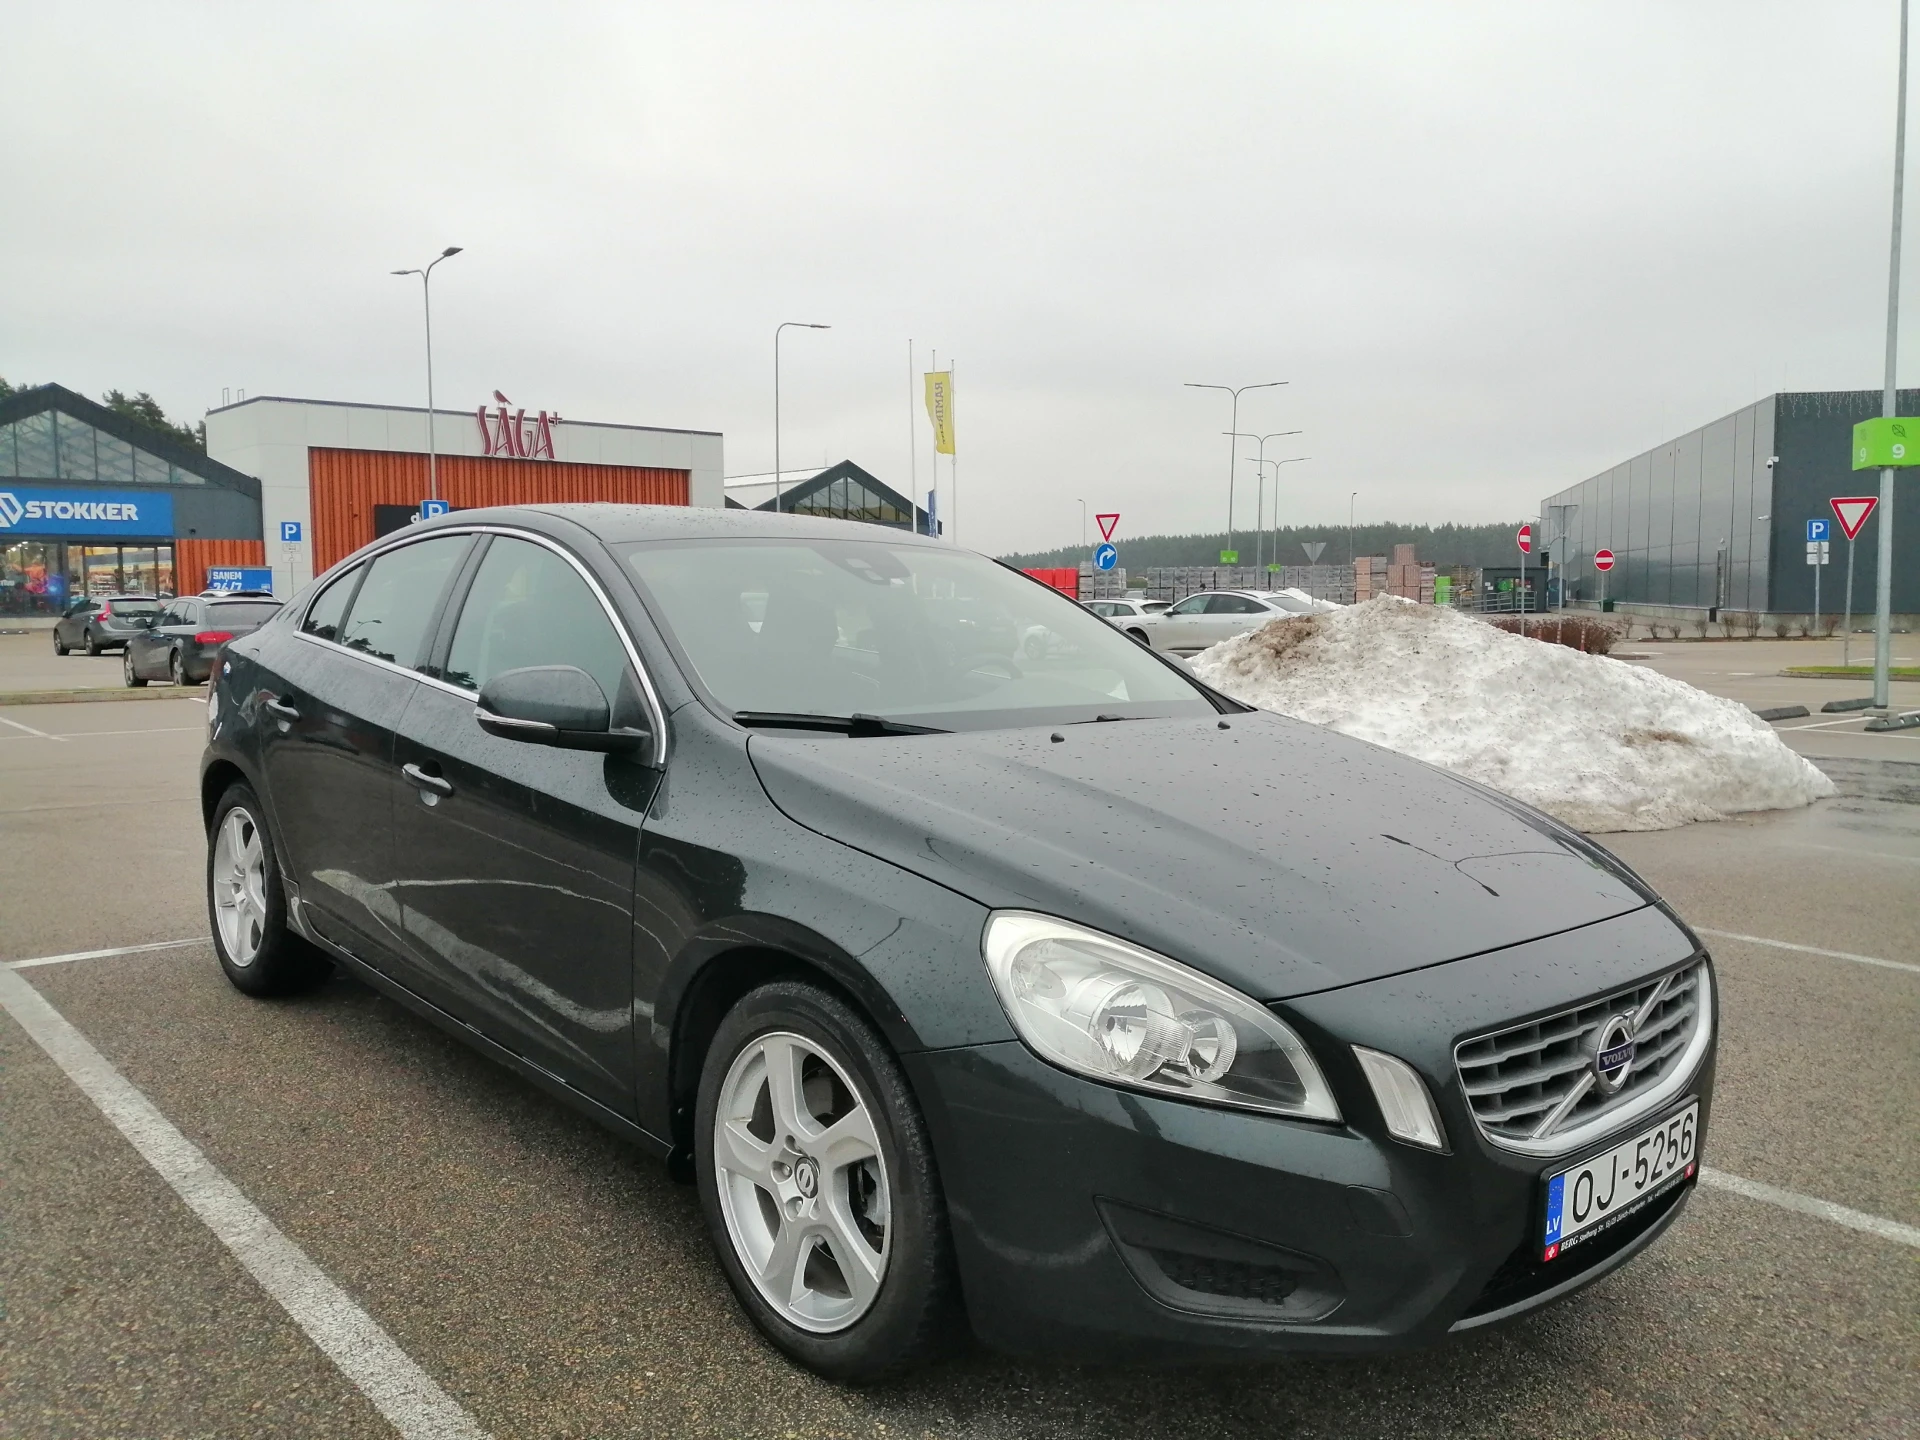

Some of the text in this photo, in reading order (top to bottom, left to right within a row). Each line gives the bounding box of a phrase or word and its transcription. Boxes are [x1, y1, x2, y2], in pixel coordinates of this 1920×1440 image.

[1860, 447, 1867, 462] 9
[1892, 443, 1905, 459] 9
[25, 501, 139, 520] STOKKER
[428, 504, 443, 520] P
[285, 523, 297, 540] P
[1812, 522, 1825, 539] P
[1602, 1045, 1635, 1066] VOLVO
[1572, 1112, 1694, 1223] OJ-5256
[1546, 1215, 1561, 1235] LV
[1560, 1235, 1579, 1252] BERG
